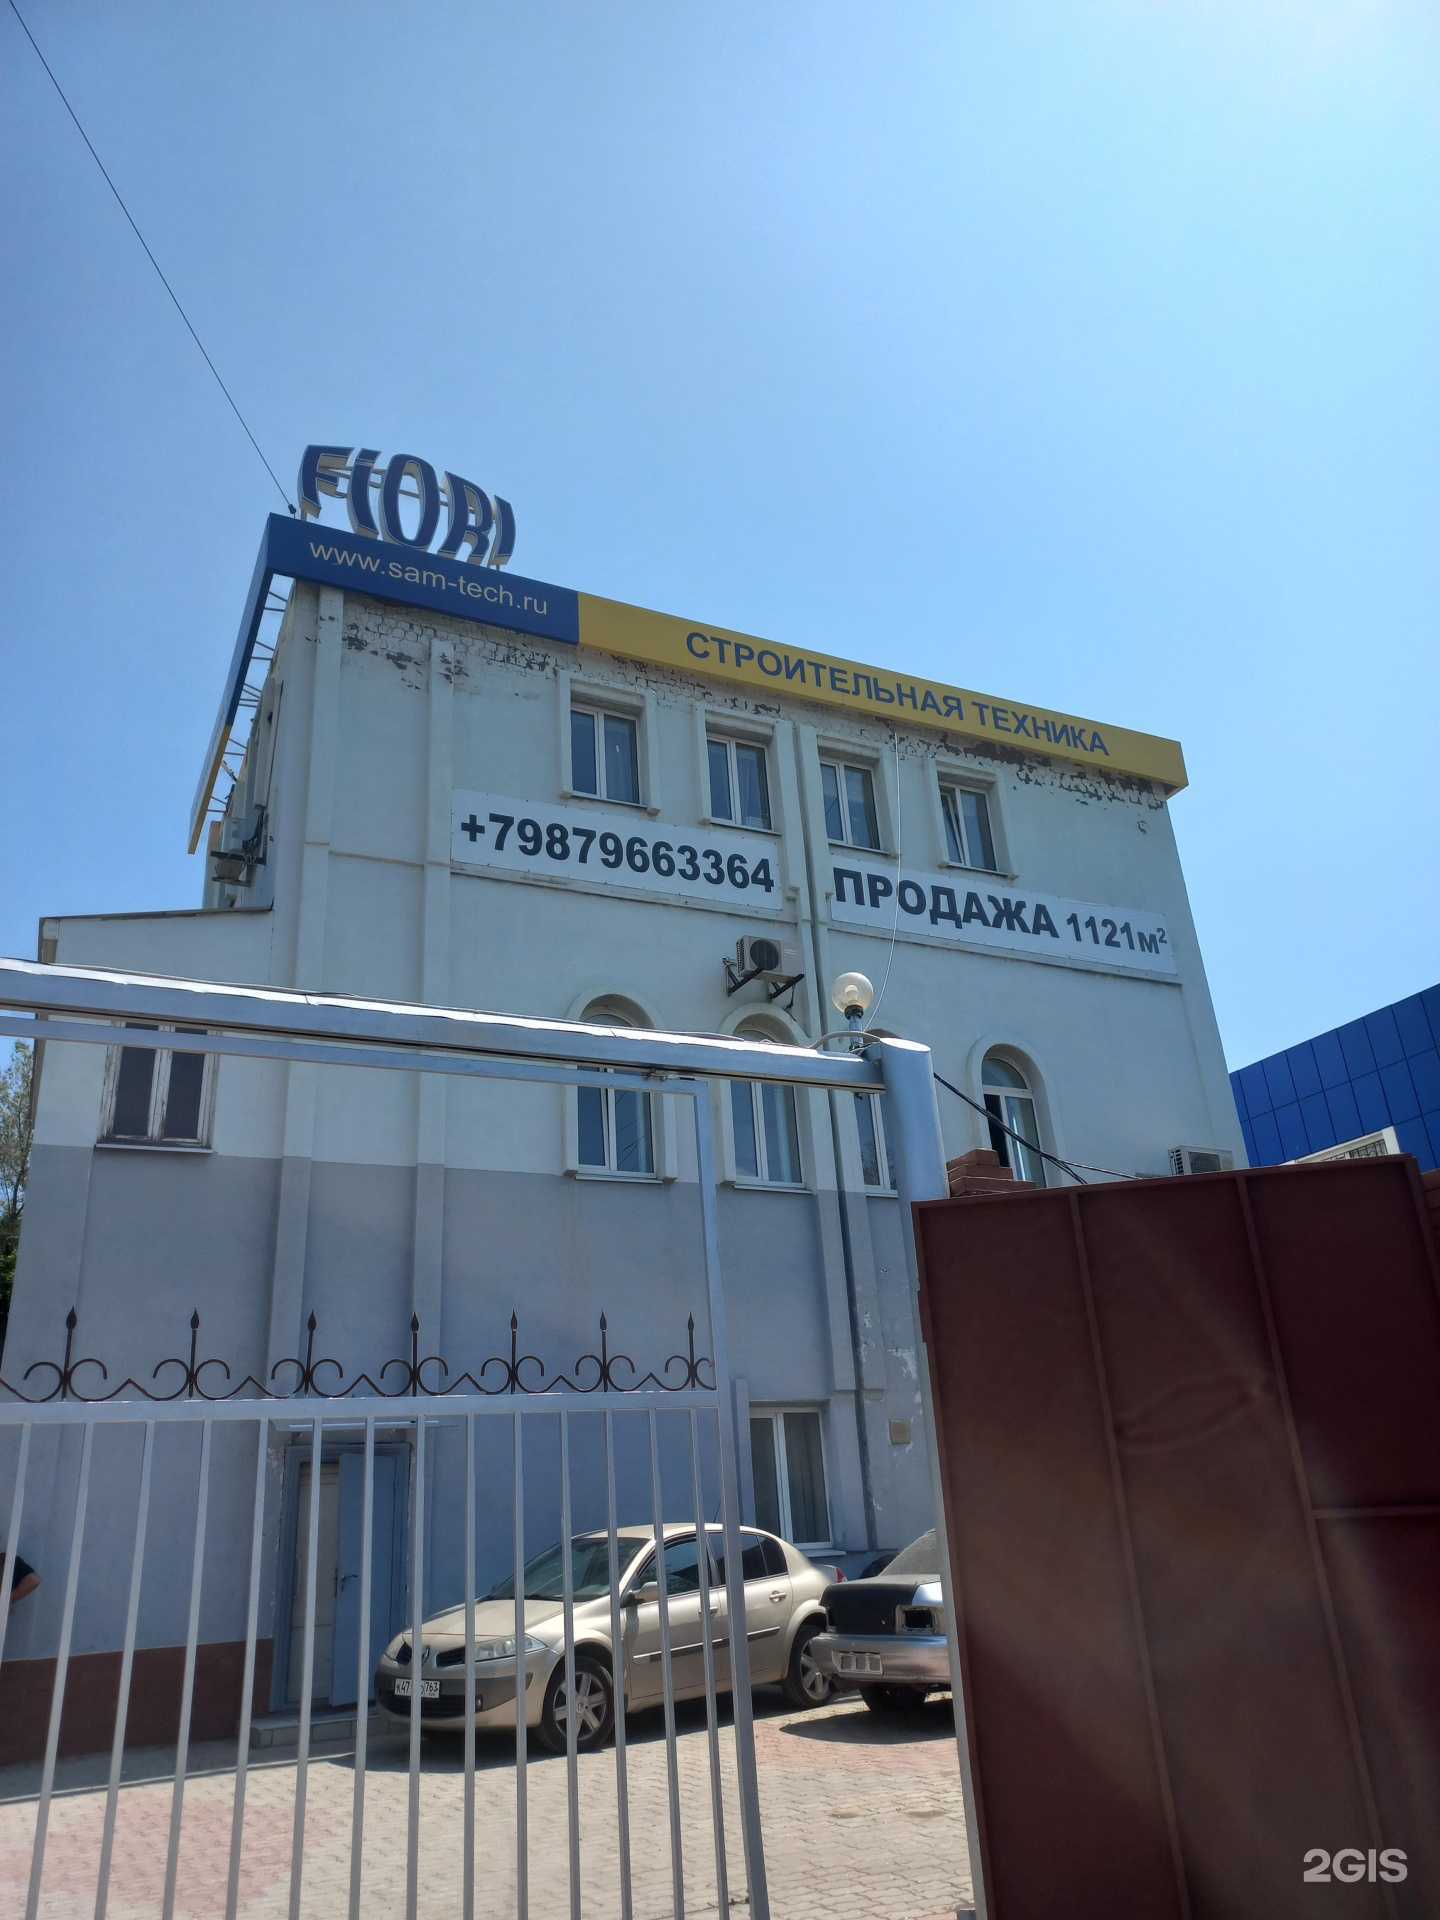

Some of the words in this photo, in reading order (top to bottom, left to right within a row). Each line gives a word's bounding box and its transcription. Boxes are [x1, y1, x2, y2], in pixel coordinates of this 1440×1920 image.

[298, 444, 516, 567] FIORI
[308, 541, 548, 616] www.sam-tech.ru
[686, 631, 964, 721] СТРОИТЕЛЬНАЯ
[970, 700, 1111, 757] ТЕХНИКА
[460, 812, 775, 893] +79879663364
[833, 867, 1060, 939] ПРОДАЖА
